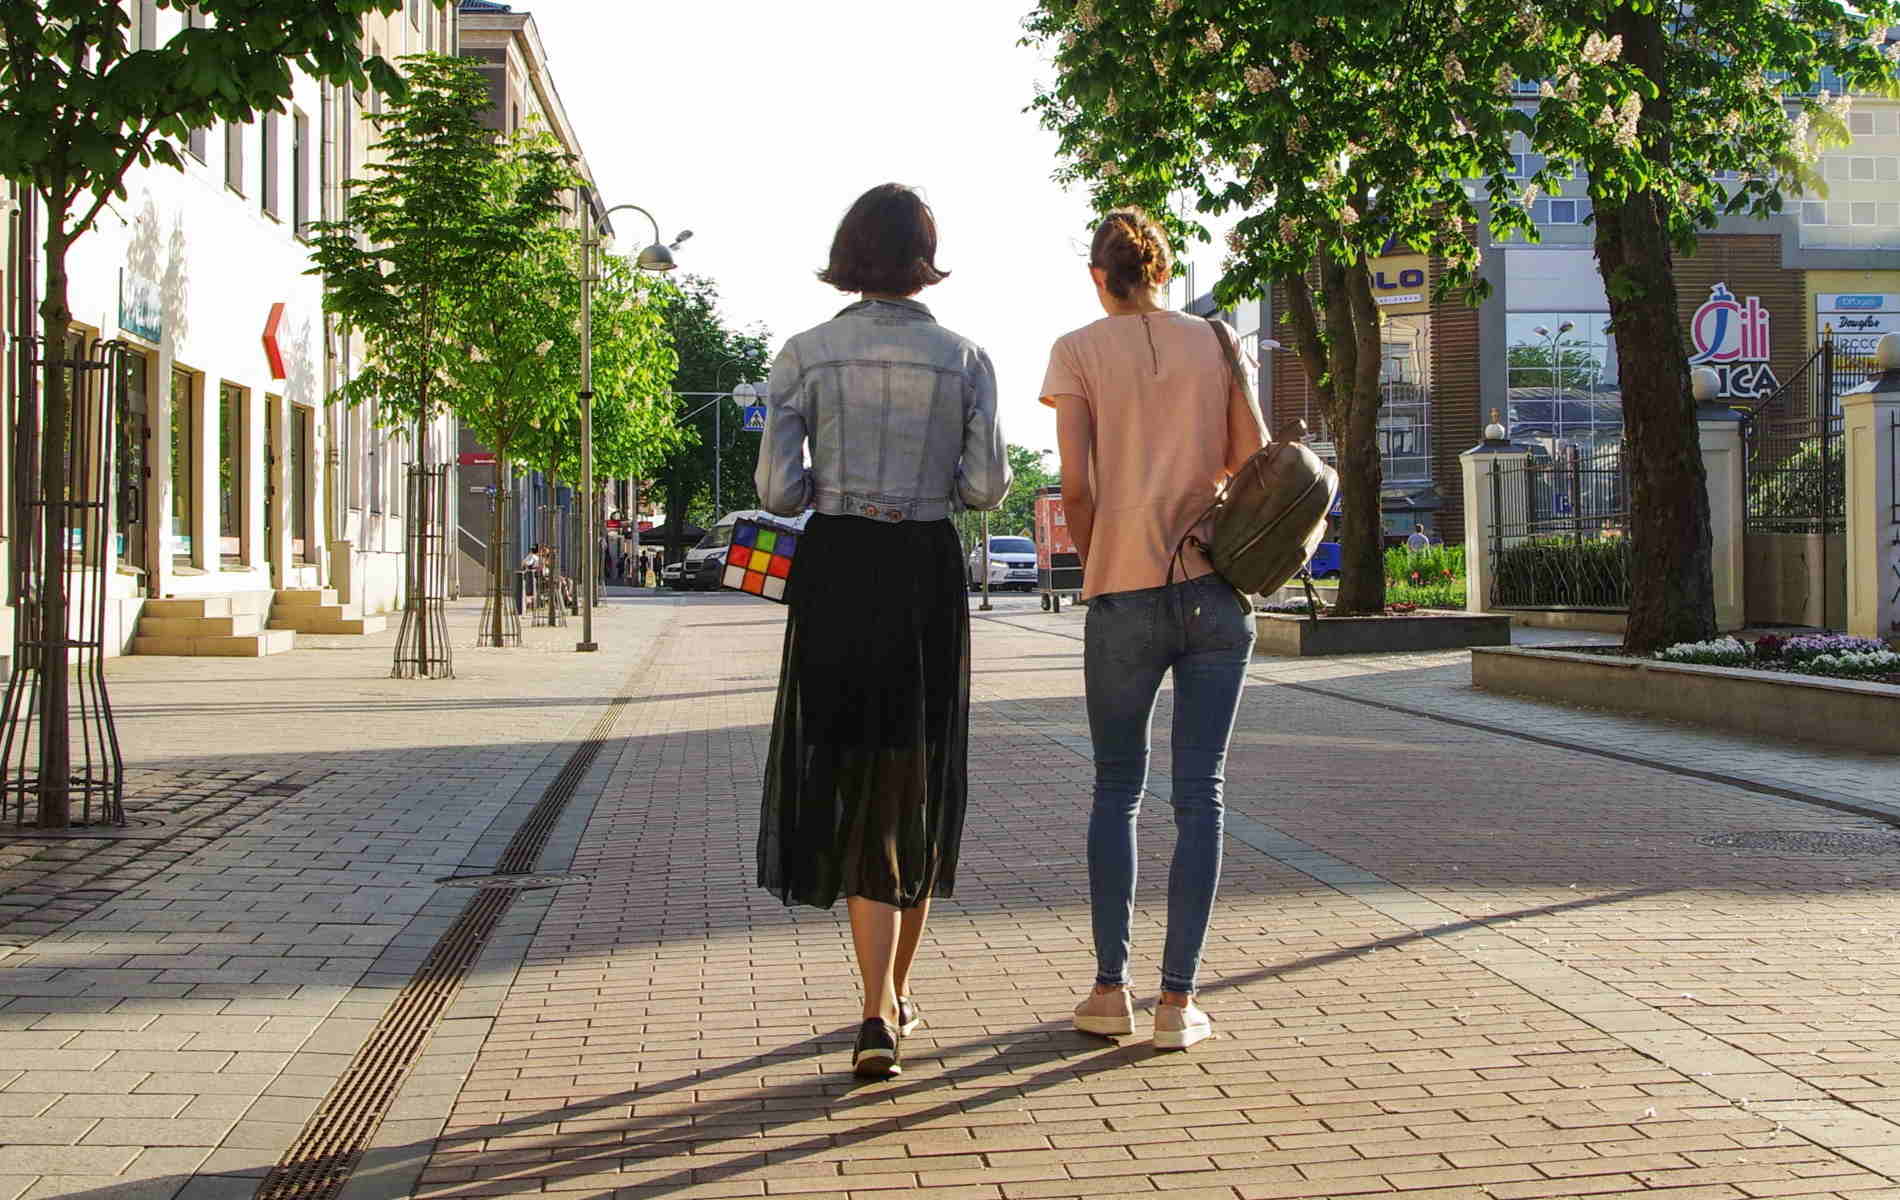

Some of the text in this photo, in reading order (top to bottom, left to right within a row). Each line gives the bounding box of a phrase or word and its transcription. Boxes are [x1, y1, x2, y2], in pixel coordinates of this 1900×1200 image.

[1370, 269, 1424, 288] LO
[1839, 315, 1880, 331] Douglas
[1692, 364, 1780, 398] ICA
